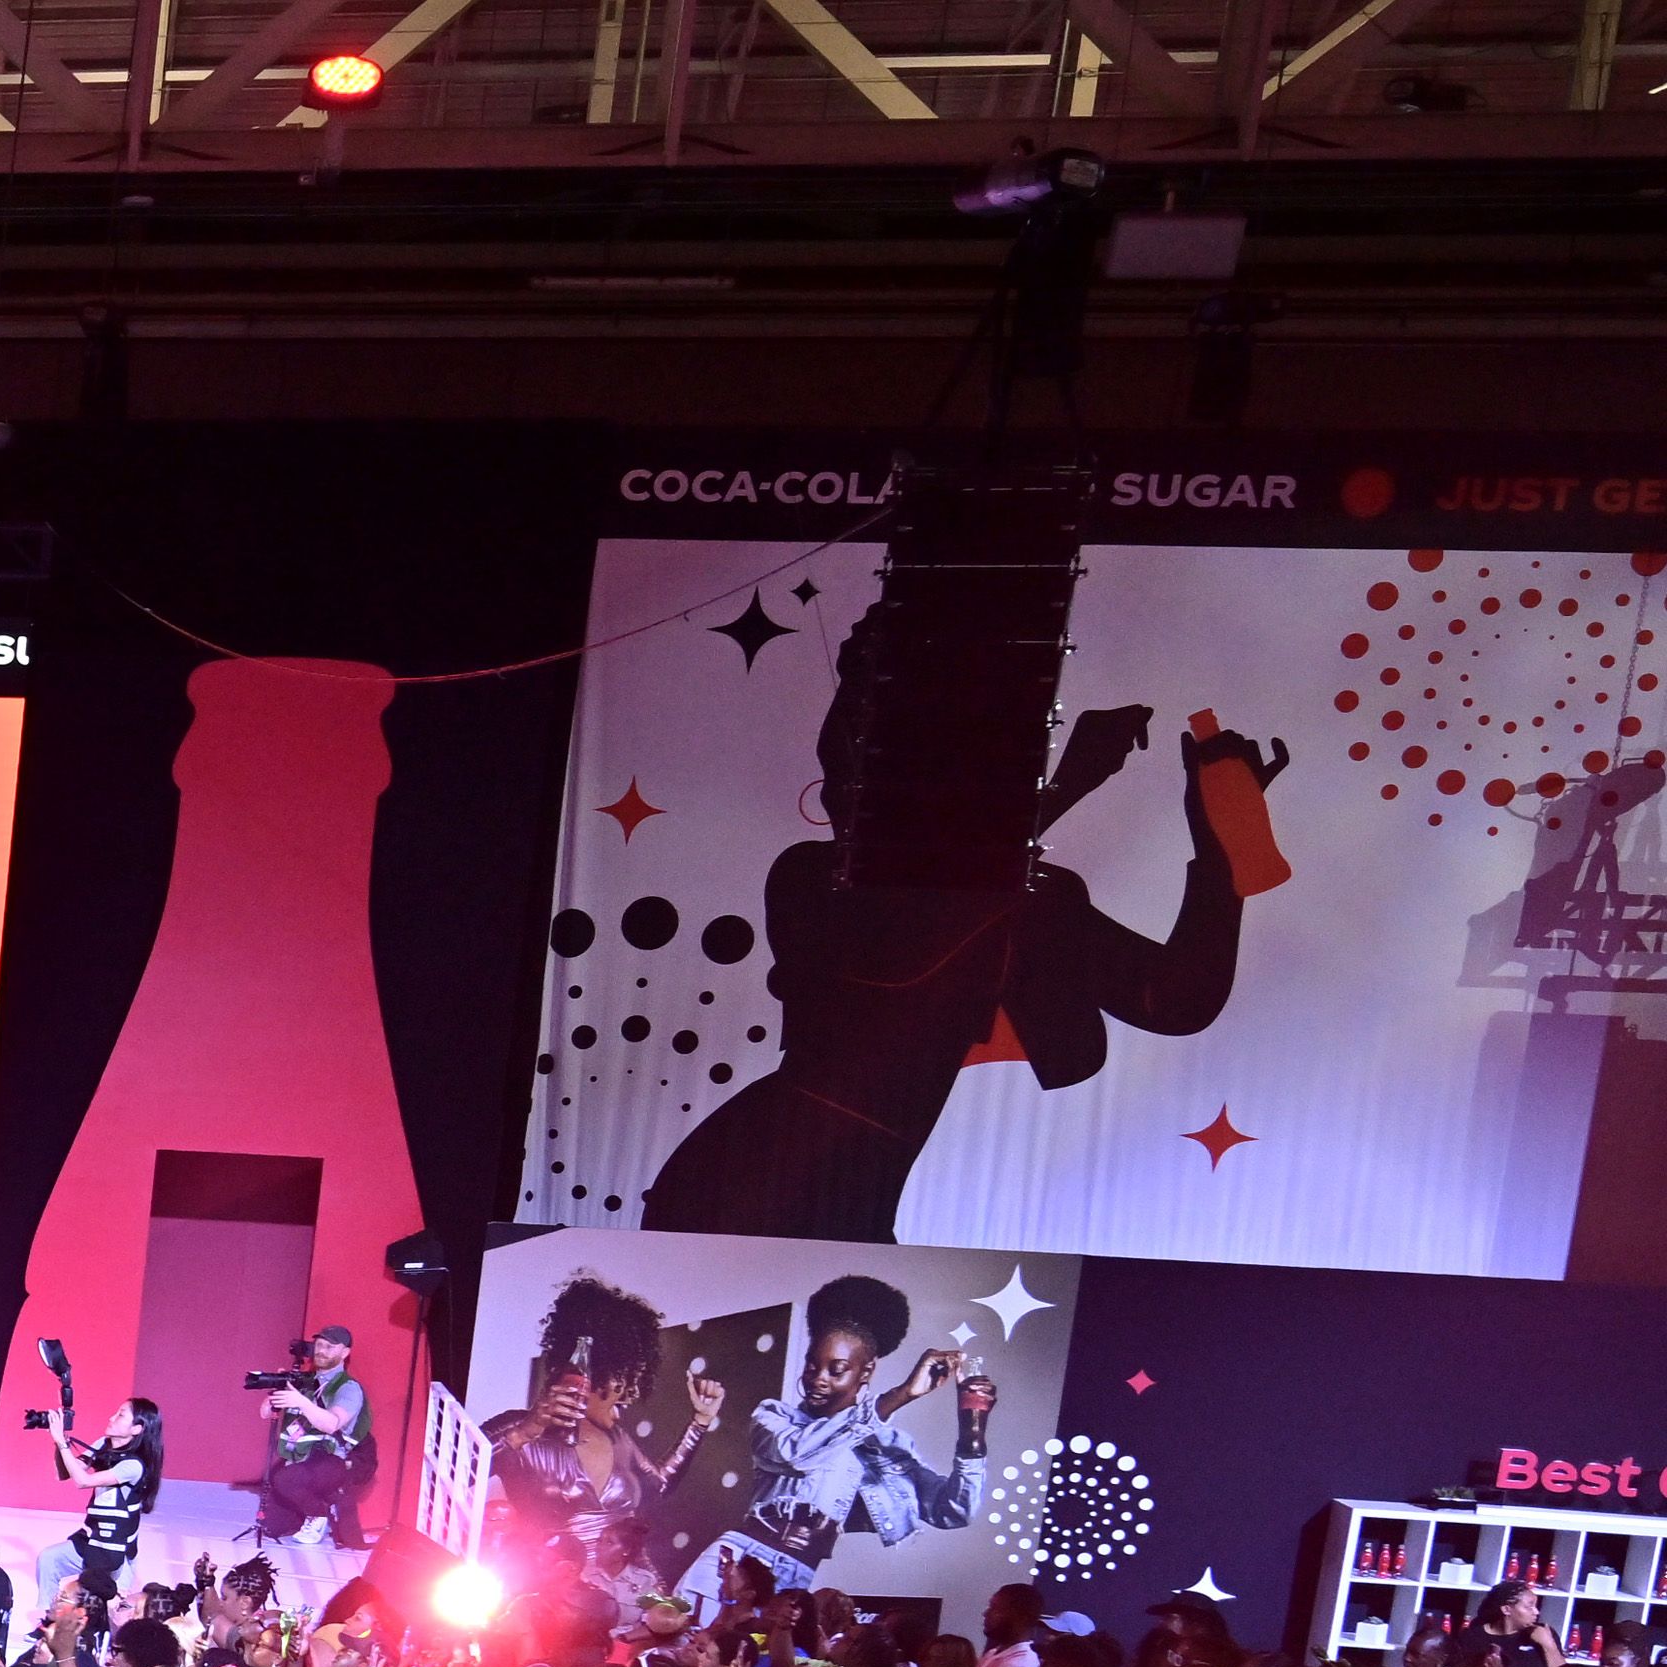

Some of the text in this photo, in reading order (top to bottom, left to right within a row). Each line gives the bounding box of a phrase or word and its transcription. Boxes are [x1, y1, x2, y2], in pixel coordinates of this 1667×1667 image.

[1111, 472, 1297, 509] SUGAR
[1435, 476, 1581, 512] JUST
[1495, 1447, 1642, 1498] Best
